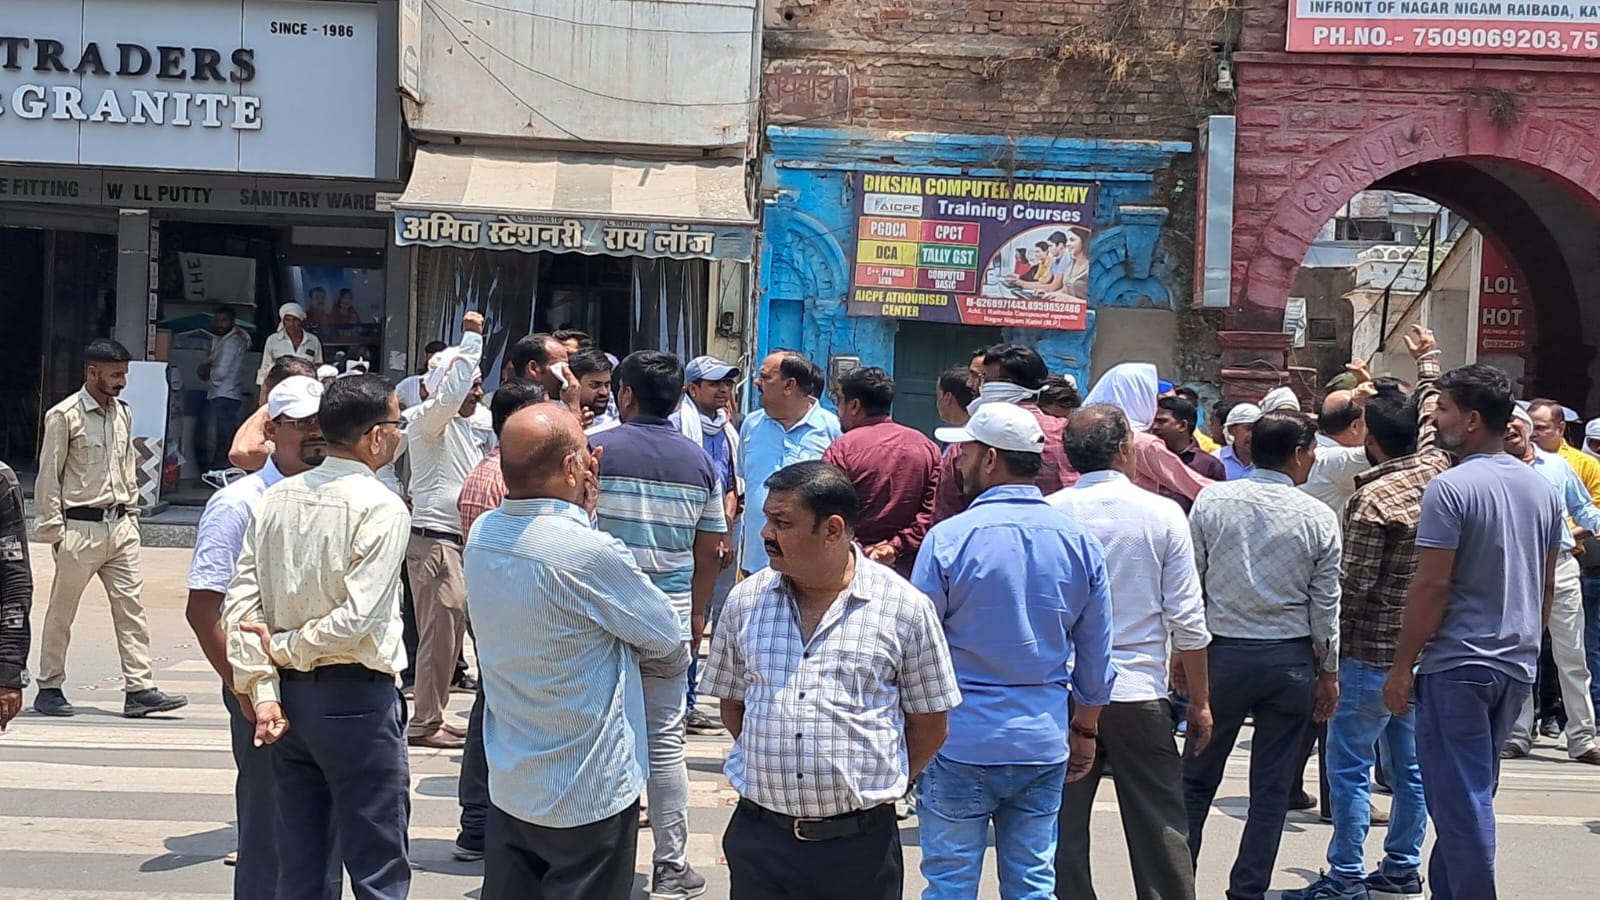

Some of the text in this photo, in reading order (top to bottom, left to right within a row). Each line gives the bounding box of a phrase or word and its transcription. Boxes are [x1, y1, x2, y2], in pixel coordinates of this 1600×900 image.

[1309, 1, 1372, 14] INFRONT
[1377, 1, 1396, 14] OF
[1400, 1, 1449, 15] NAGAR
[1454, 3, 1502, 16] NIGAM
[1506, 4, 1574, 19] RAIBADA,
[270, 21, 308, 36] SINCE
[321, 24, 354, 38] 1986
[1312, 26, 1404, 47] PH.NO.-
[0, 36, 257, 82] TRADERS
[11, 84, 262, 130] GRANITE
[12, 178, 80, 198] FITTING
[158, 185, 213, 203] PUTTY
[863, 174, 1089, 205] DIKSHA COMPUTER ACADEMY
[239, 188, 321, 208] SANITARY
[326, 192, 375, 210] WARE
[880, 203, 921, 213] AICPE
[937, 199, 1081, 223] Training Courses
[402, 212, 584, 248] अमित स्टेशनरी
[870, 221, 907, 237] PGDCA
[935, 225, 964, 241] CPCT
[603, 227, 648, 252] राय
[653, 223, 716, 255] लॉज
[876, 245, 898, 260] DCA
[922, 248, 974, 265] TALLY GST
[186, 256, 205, 297] THE
[855, 289, 884, 303] AICPE
[881, 304, 919, 318] CENTER
